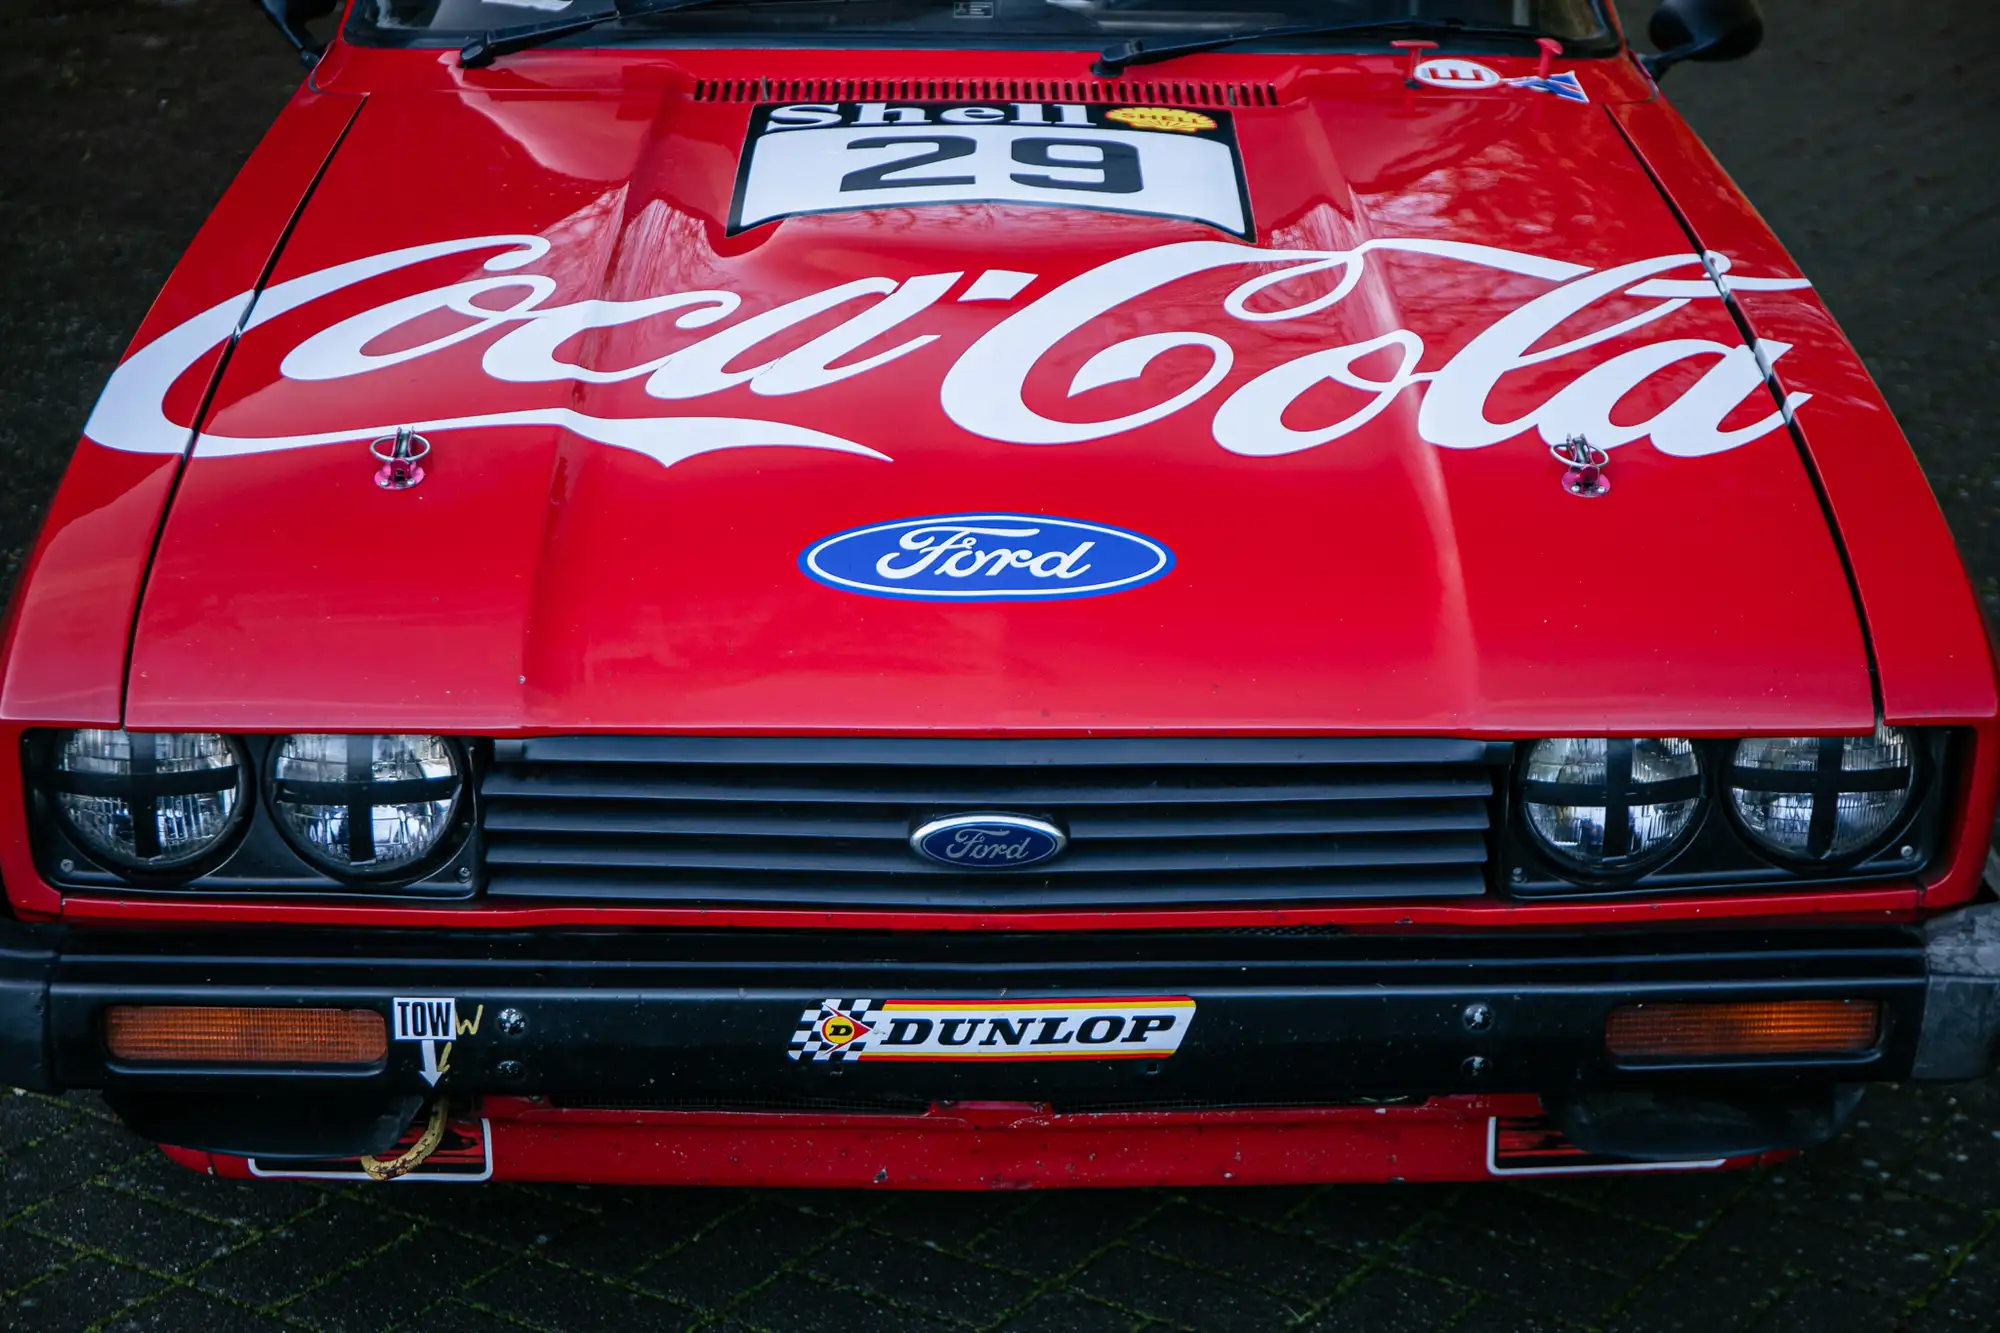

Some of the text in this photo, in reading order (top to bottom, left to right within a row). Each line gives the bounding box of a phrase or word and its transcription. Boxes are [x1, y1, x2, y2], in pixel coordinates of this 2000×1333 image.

[768, 103, 1098, 131] Shell
[839, 135, 1144, 194] 29
[84, 235, 1813, 467] Coca-Cola
[876, 526, 1096, 580] Ford
[946, 829, 1032, 859] Ford
[397, 1002, 452, 1037] TOW
[828, 1024, 854, 1037] D
[880, 1015, 1177, 1046] DUNLOP
